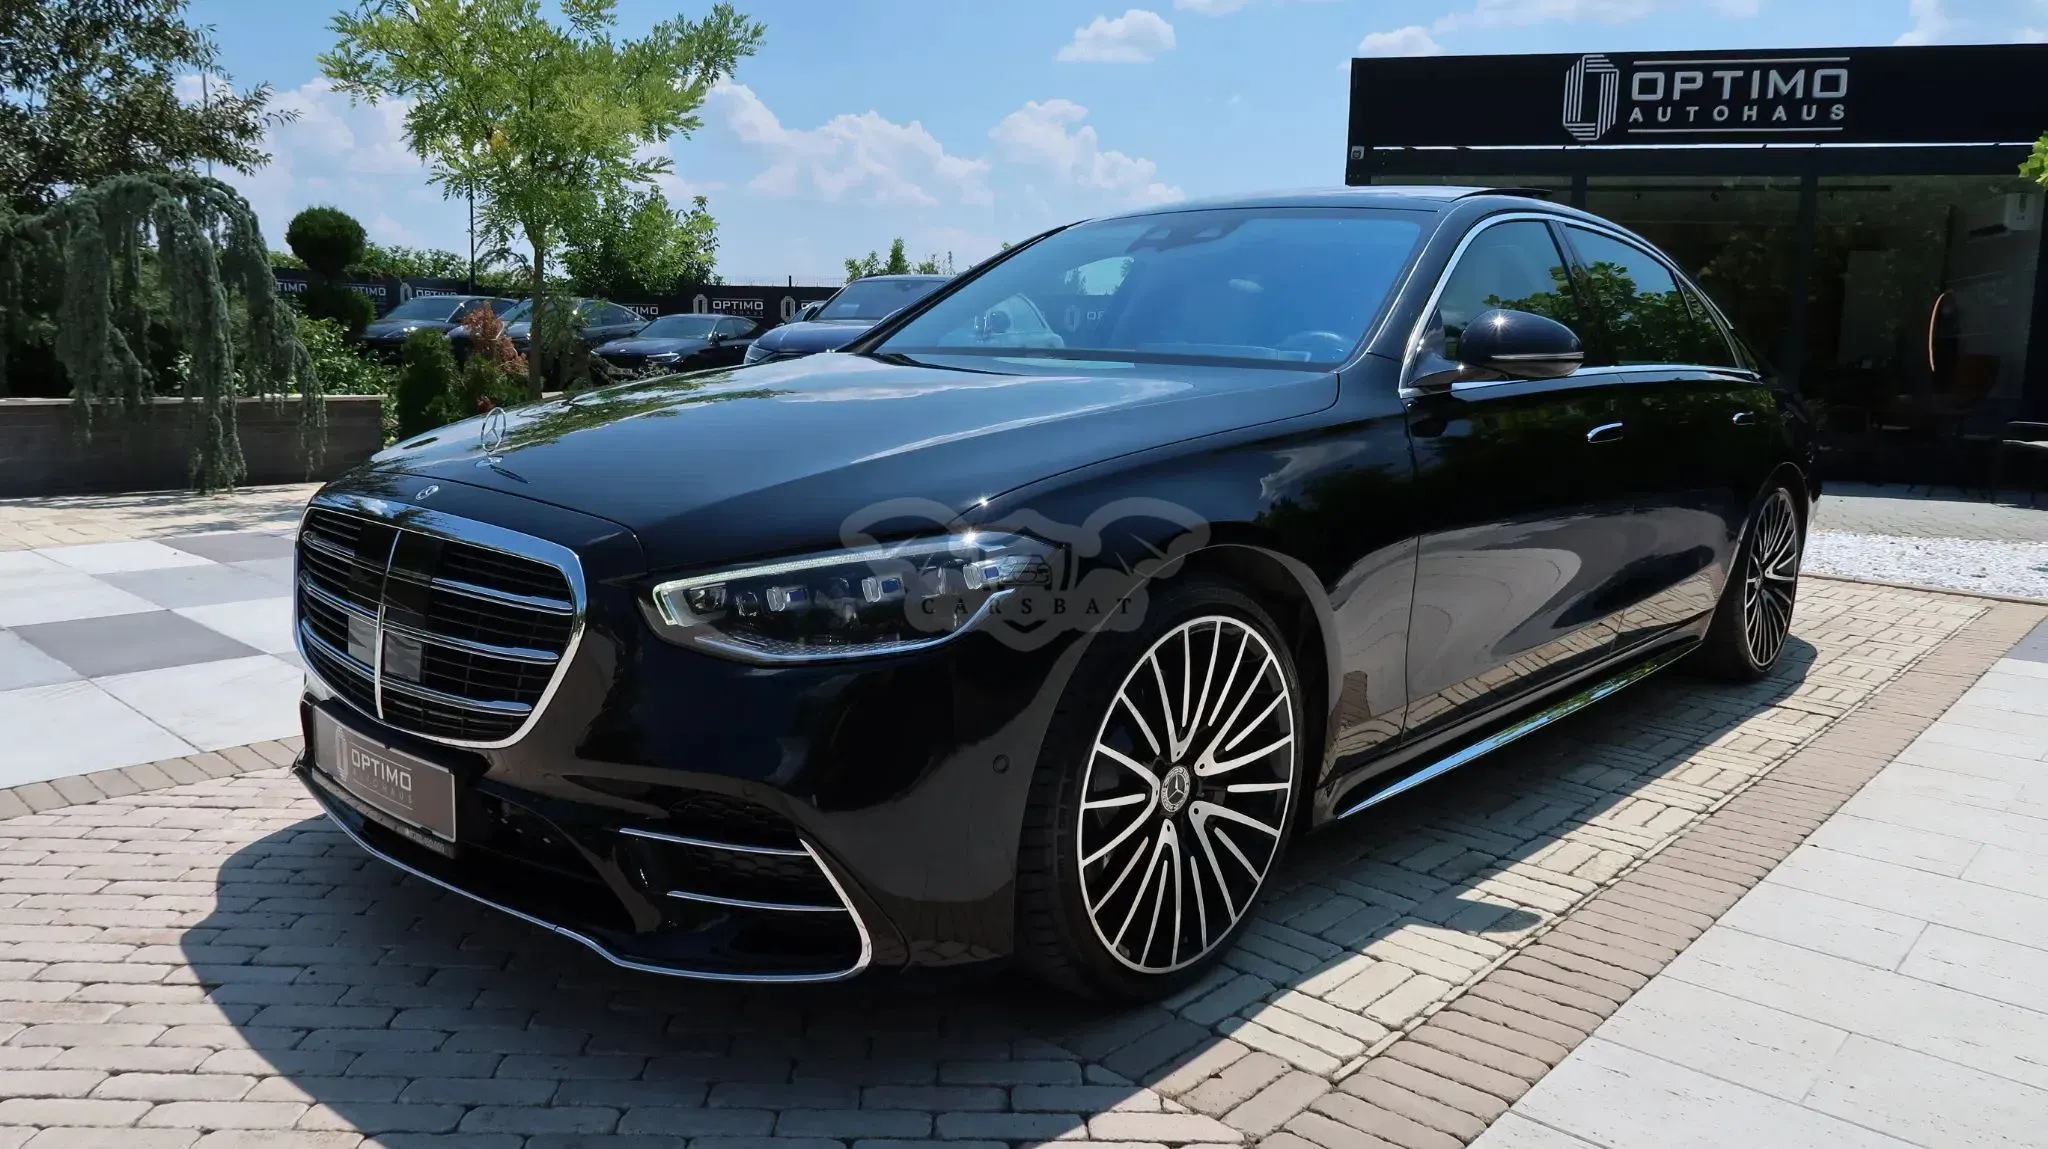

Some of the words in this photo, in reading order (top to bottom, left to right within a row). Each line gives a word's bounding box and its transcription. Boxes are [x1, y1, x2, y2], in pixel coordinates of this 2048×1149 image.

[1631, 68, 1848, 100] OPTIMO
[1628, 104, 1845, 122] AUTOHAUS
[712, 300, 764, 310] OPTIMO
[351, 748, 412, 791] OPTIMO
